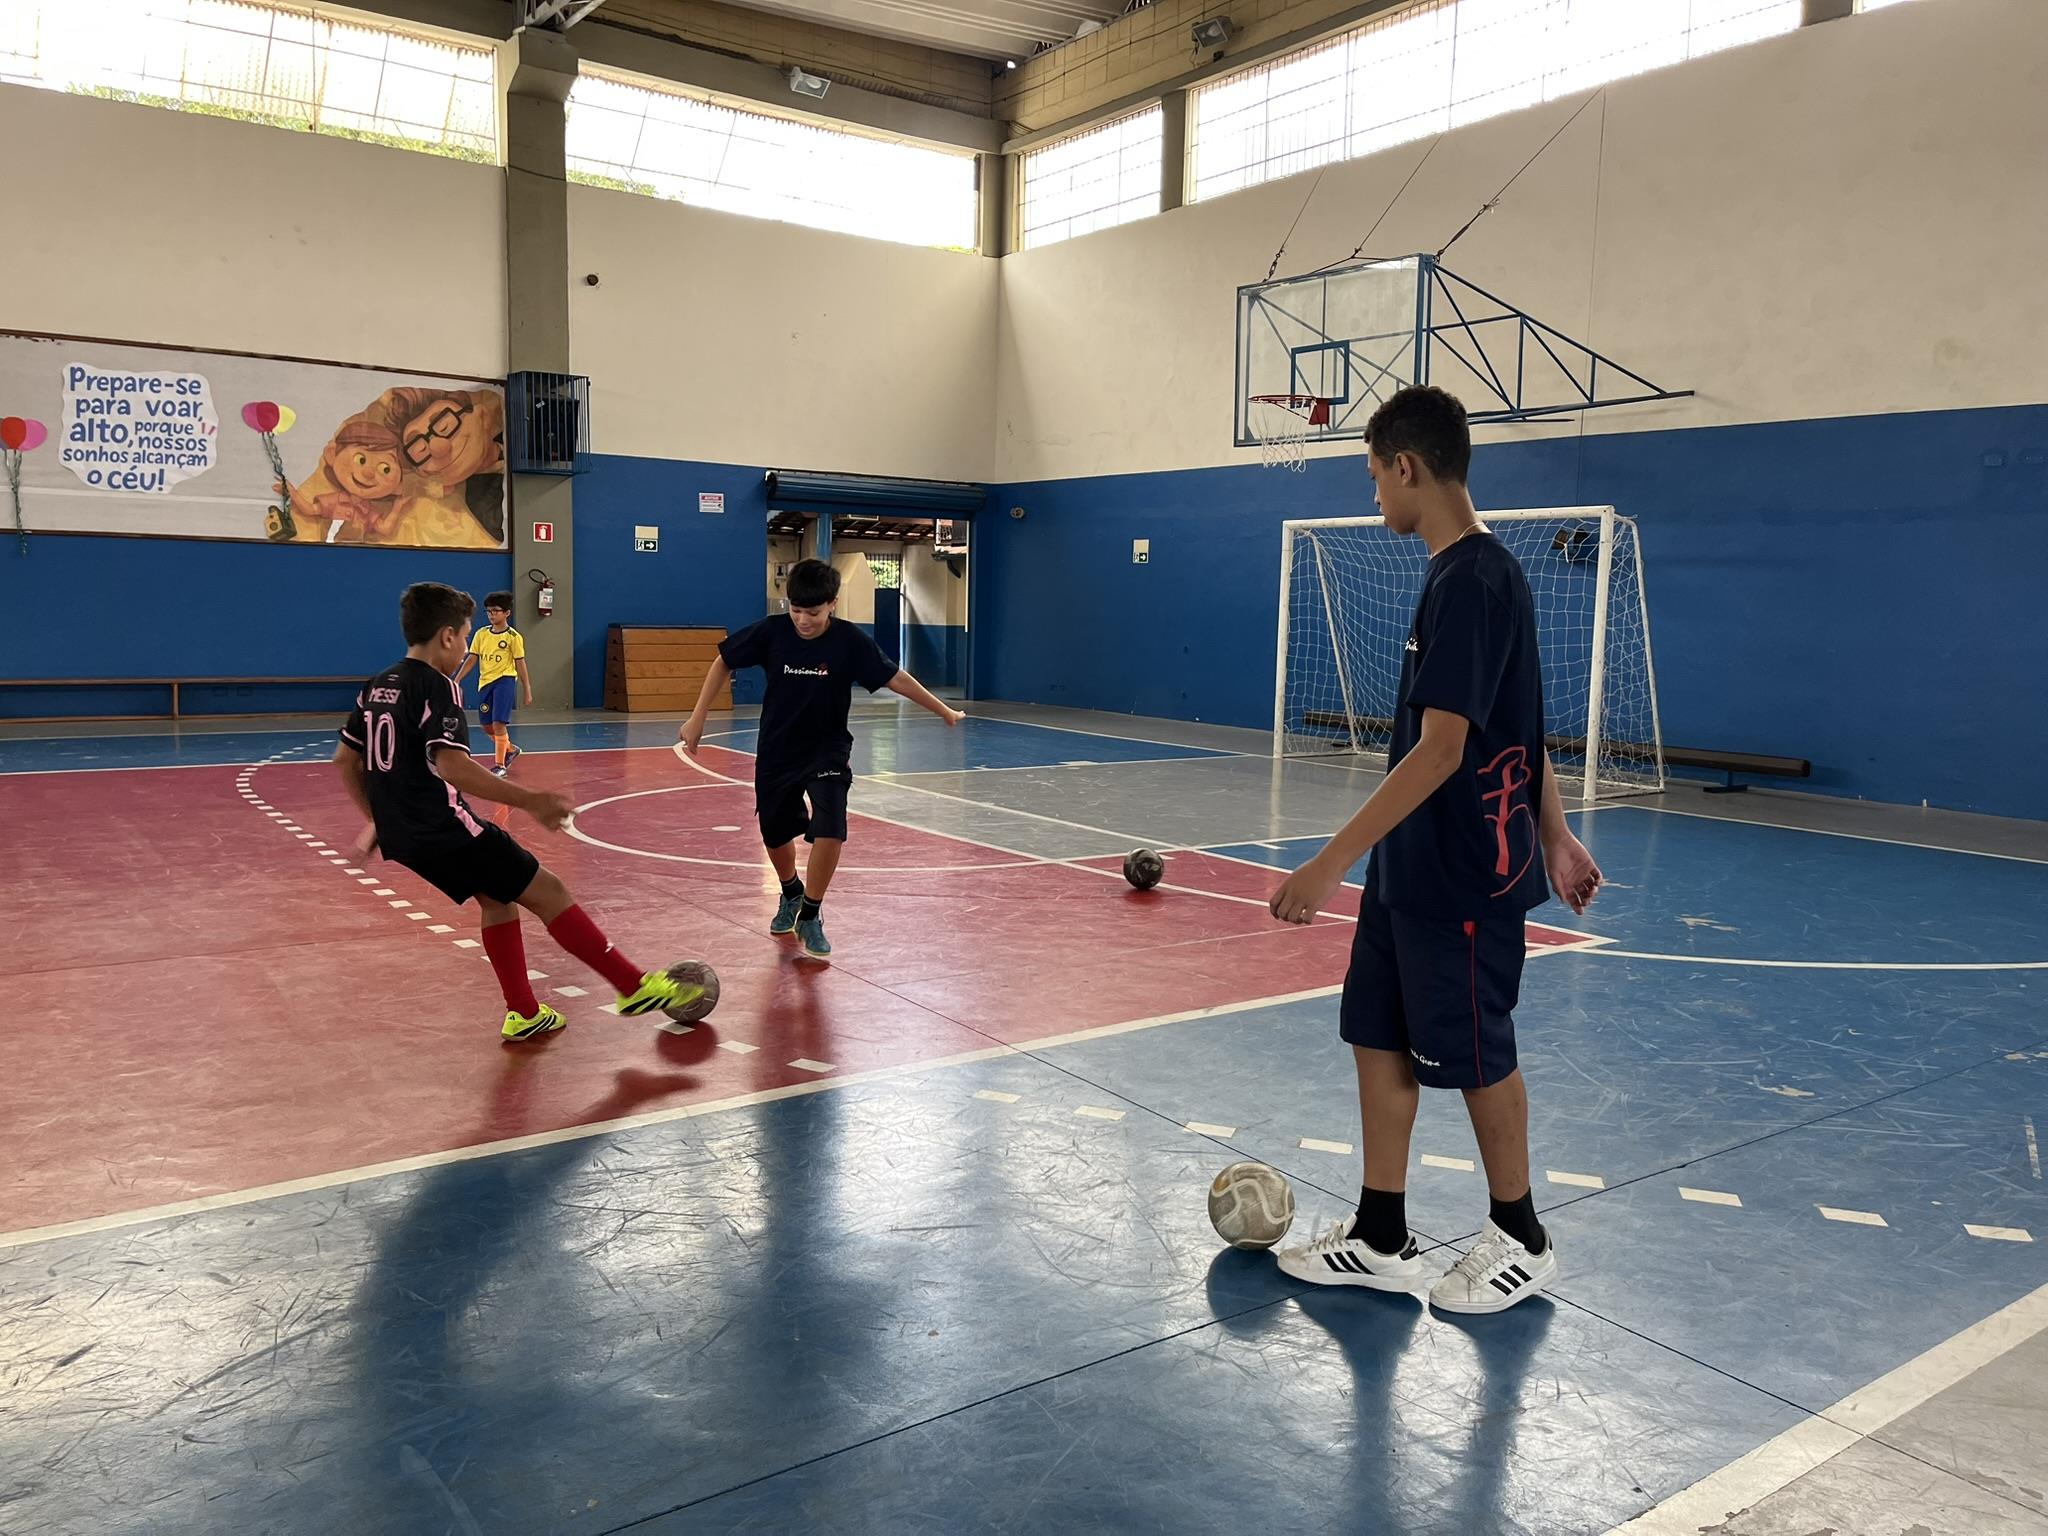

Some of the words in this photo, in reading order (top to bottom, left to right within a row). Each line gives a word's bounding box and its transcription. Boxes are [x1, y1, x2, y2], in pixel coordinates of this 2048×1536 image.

[70, 366, 202, 398] Prepare-se
[76, 397, 131, 418] para
[145, 400, 203, 422] voar,
[70, 418, 134, 448] alto,
[134, 421, 194, 437] porque
[138, 435, 207, 452] nossos
[63, 446, 128, 463] sonhos
[132, 450, 208, 468] alcançam
[87, 469, 103, 485] o
[107, 465, 165, 491] céu!
[368, 687, 401, 705] MESSI
[363, 710, 396, 773] 10
